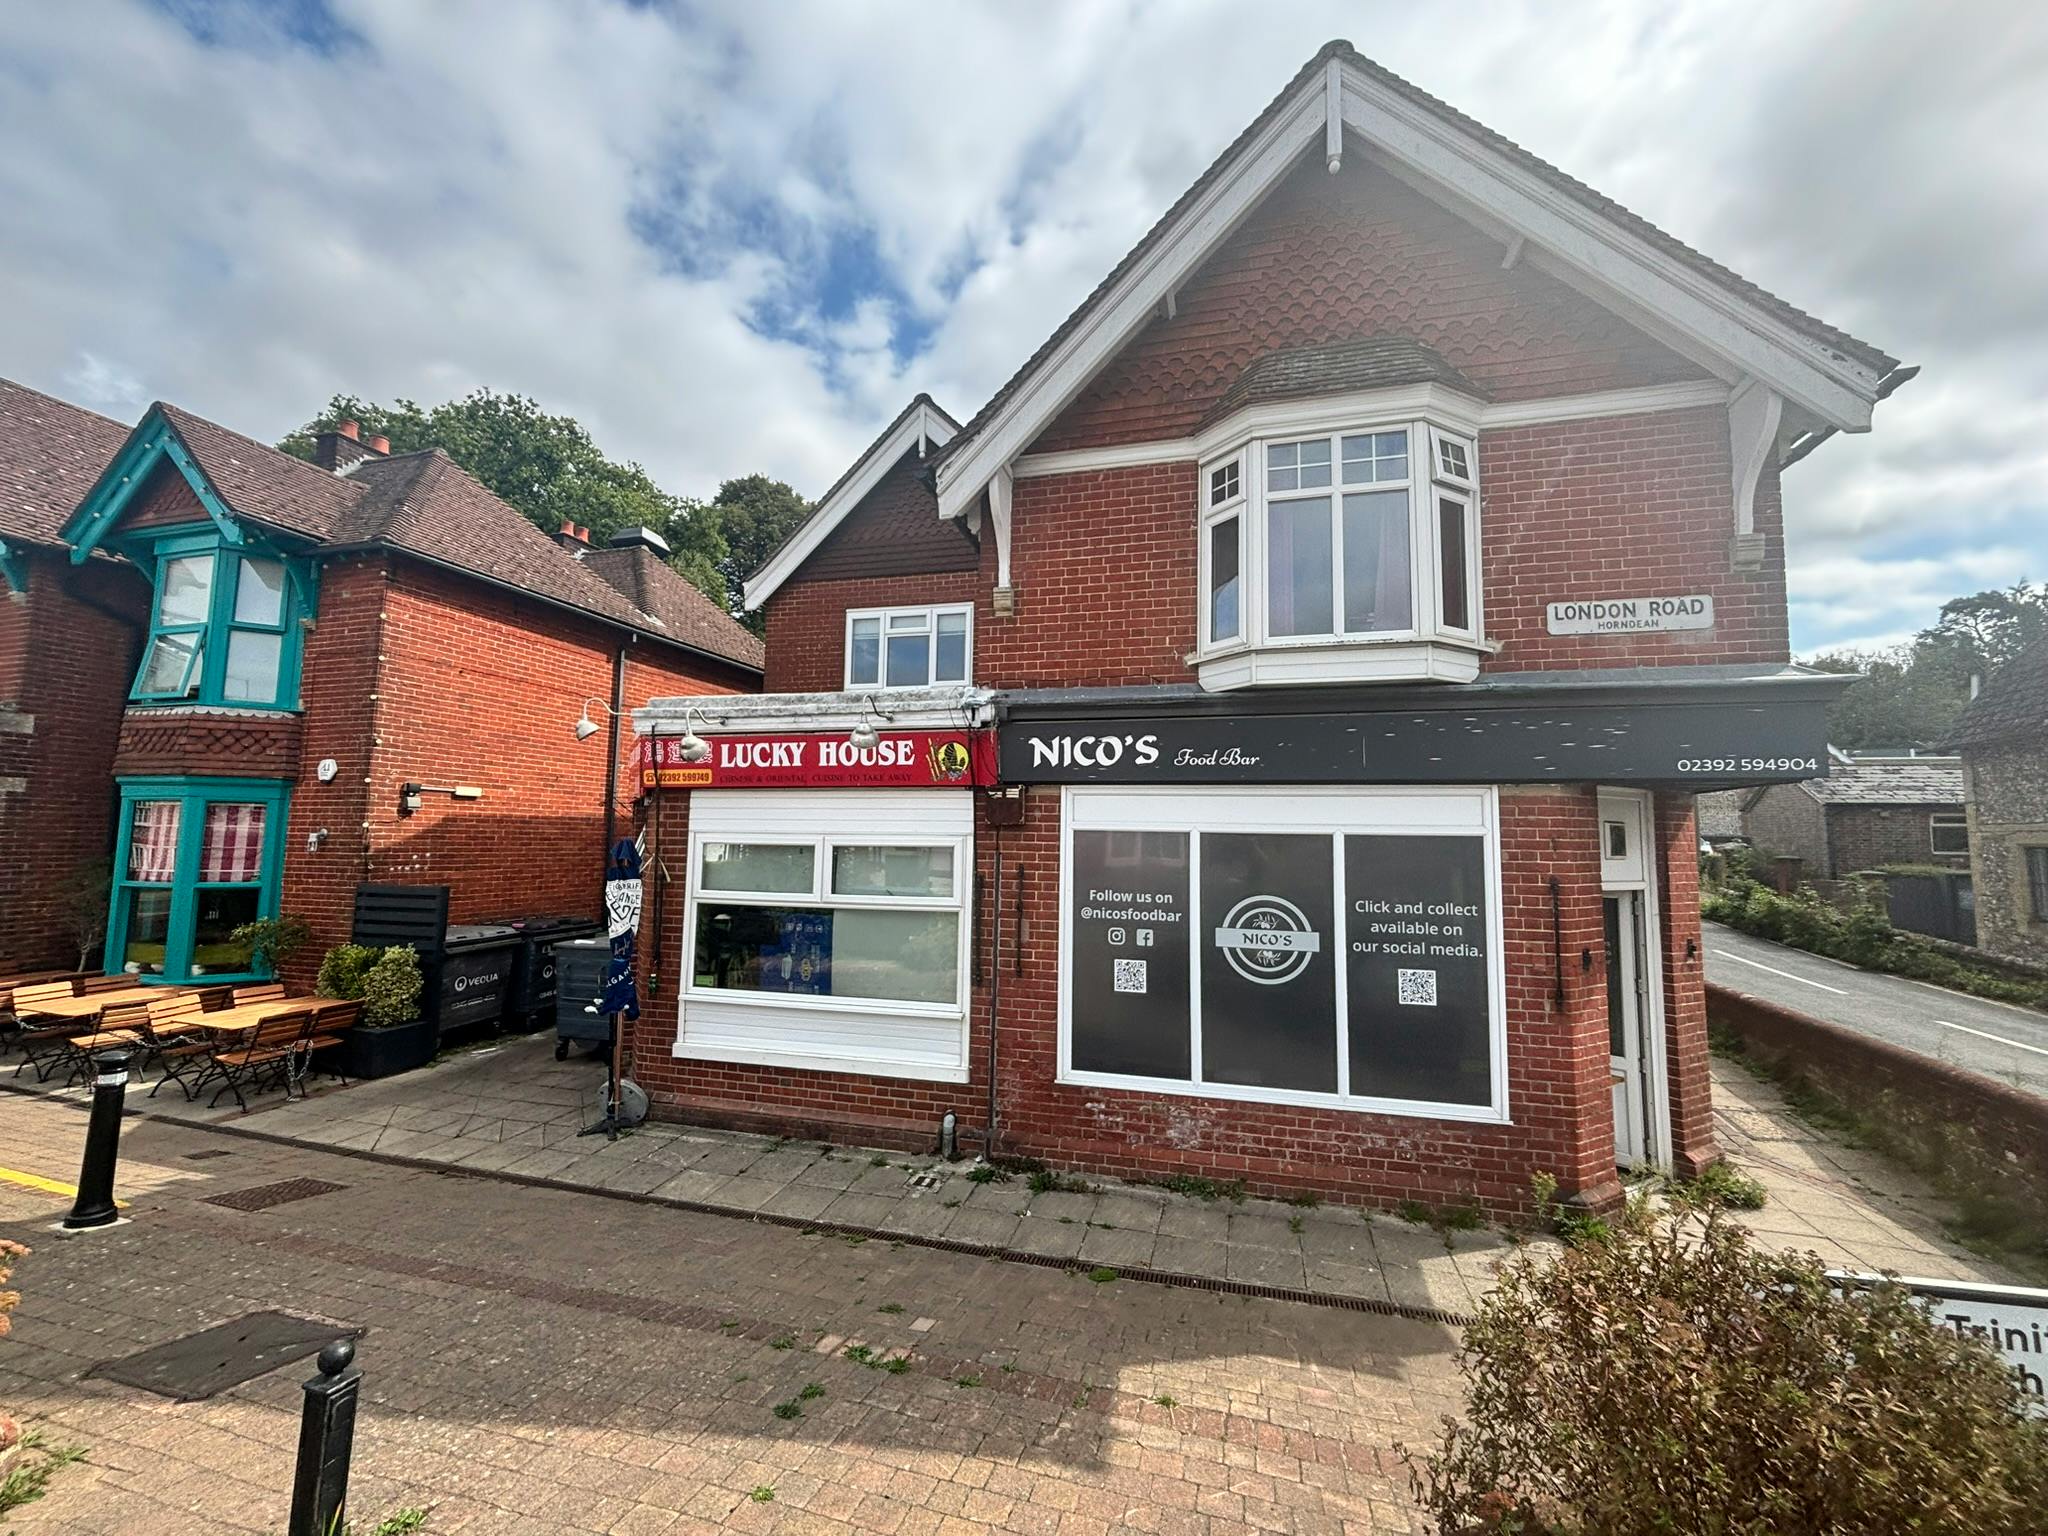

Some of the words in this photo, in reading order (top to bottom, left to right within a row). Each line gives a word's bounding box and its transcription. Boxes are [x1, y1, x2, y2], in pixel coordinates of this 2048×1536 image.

[1554, 602, 1637, 621] LONDON
[1649, 599, 1704, 617] ROAD
[1597, 619, 1659, 630] HORNDEAN
[720, 742, 807, 768] LUCKY
[818, 739, 916, 767] HOUSE
[1028, 734, 1160, 768] NICO'S
[1173, 748, 1218, 766] Food
[1218, 747, 1260, 766] Bar
[1677, 759, 1736, 772] 02392
[1741, 758, 1818, 771] 594904
[849, 774, 860, 782] TO
[863, 774, 883, 782] TAKE
[888, 773, 912, 782] AWAY
[1089, 889, 1133, 903] Follow
[1136, 893, 1152, 903] us
[1155, 894, 1173, 904] on
[1080, 907, 1182, 922] @nicosfoodbar
[1355, 900, 1391, 913] Click
[1394, 901, 1423, 915] and
[1427, 902, 1479, 916] collect
[1370, 921, 1439, 935] available
[1442, 925, 1463, 936] on
[1242, 933, 1293, 947] NICO'S
[1352, 942, 1379, 953] our
[1382, 941, 1426, 955] social
[1430, 943, 1484, 957] media.
[468, 973, 499, 986] VEOLIA
